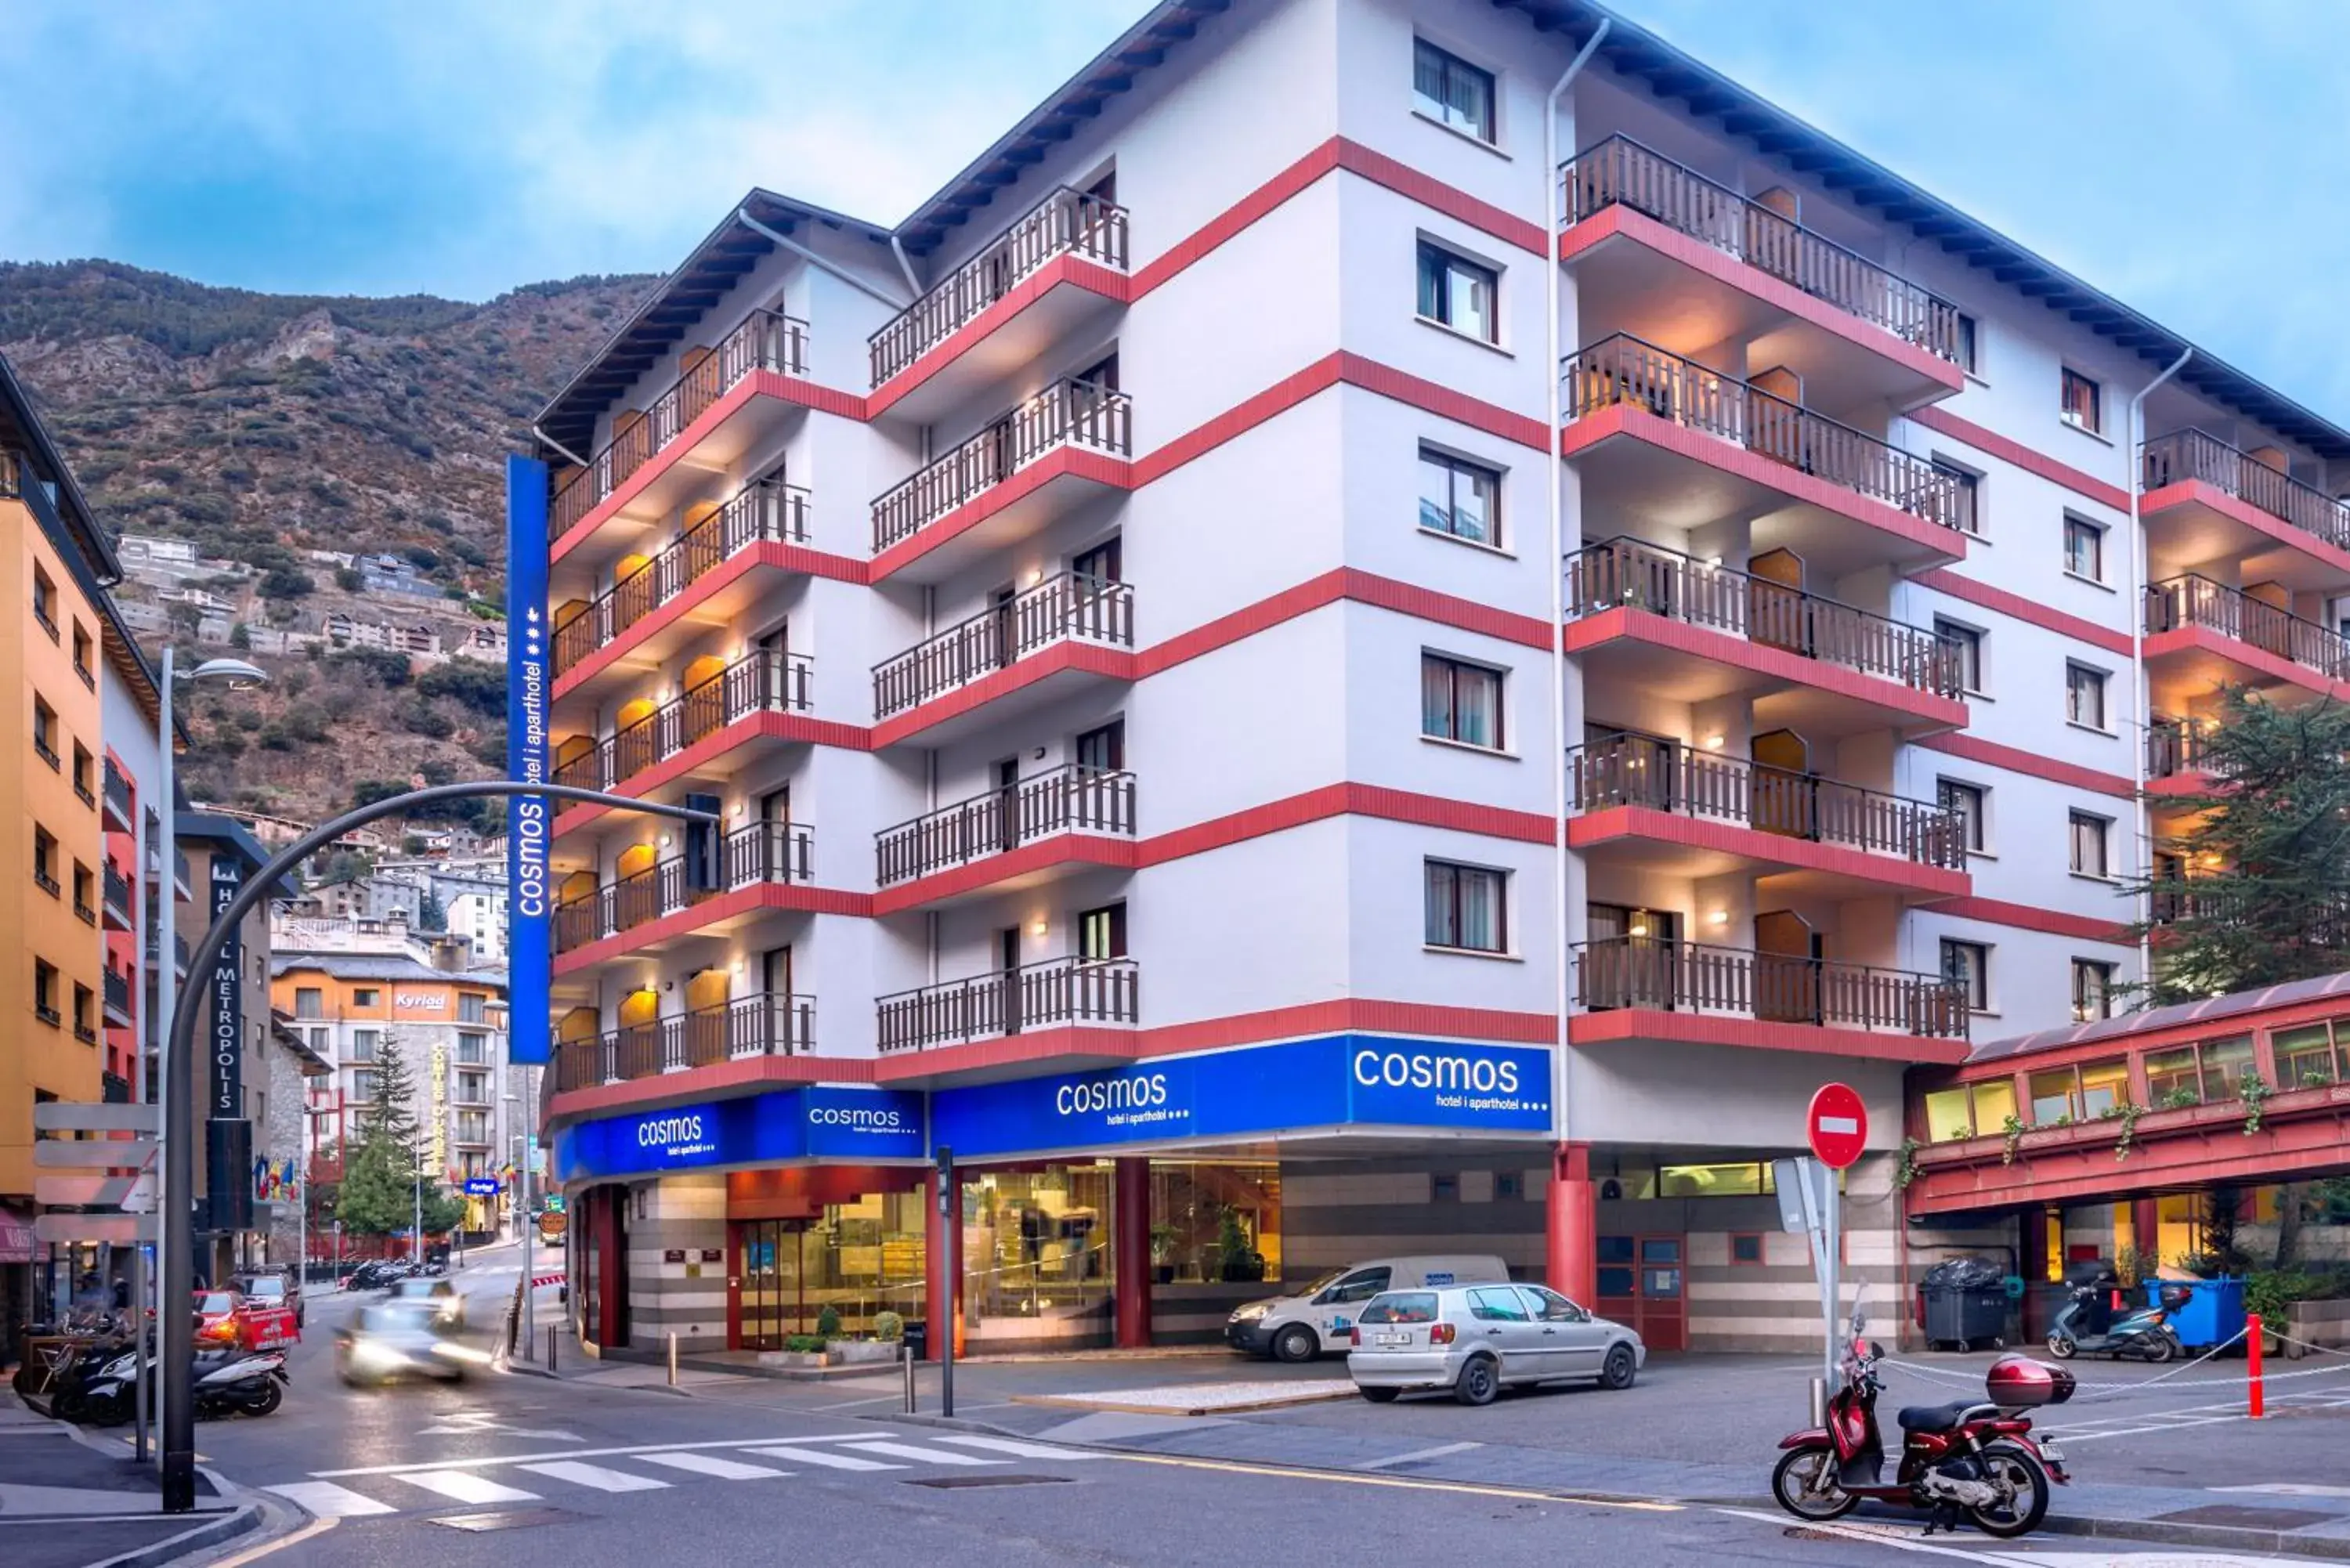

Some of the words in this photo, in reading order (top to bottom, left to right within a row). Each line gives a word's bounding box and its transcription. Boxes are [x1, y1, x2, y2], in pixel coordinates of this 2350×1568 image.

[522, 660, 546, 745] aparthotel
[519, 802, 543, 916] cosmos
[396, 992, 445, 1010] Kyriad
[215, 968, 235, 1108] METROPOLIS
[1354, 1050, 1519, 1093] cosmos
[1058, 1074, 1166, 1115] cosmos
[1436, 1094, 1462, 1107] hotel
[1469, 1097, 1519, 1111] aparthotel
[638, 1115, 702, 1147] cosmos
[809, 1108, 900, 1125] cosmos
[1107, 1113, 1125, 1125] hotel
[1130, 1108, 1166, 1127] aparthotel
